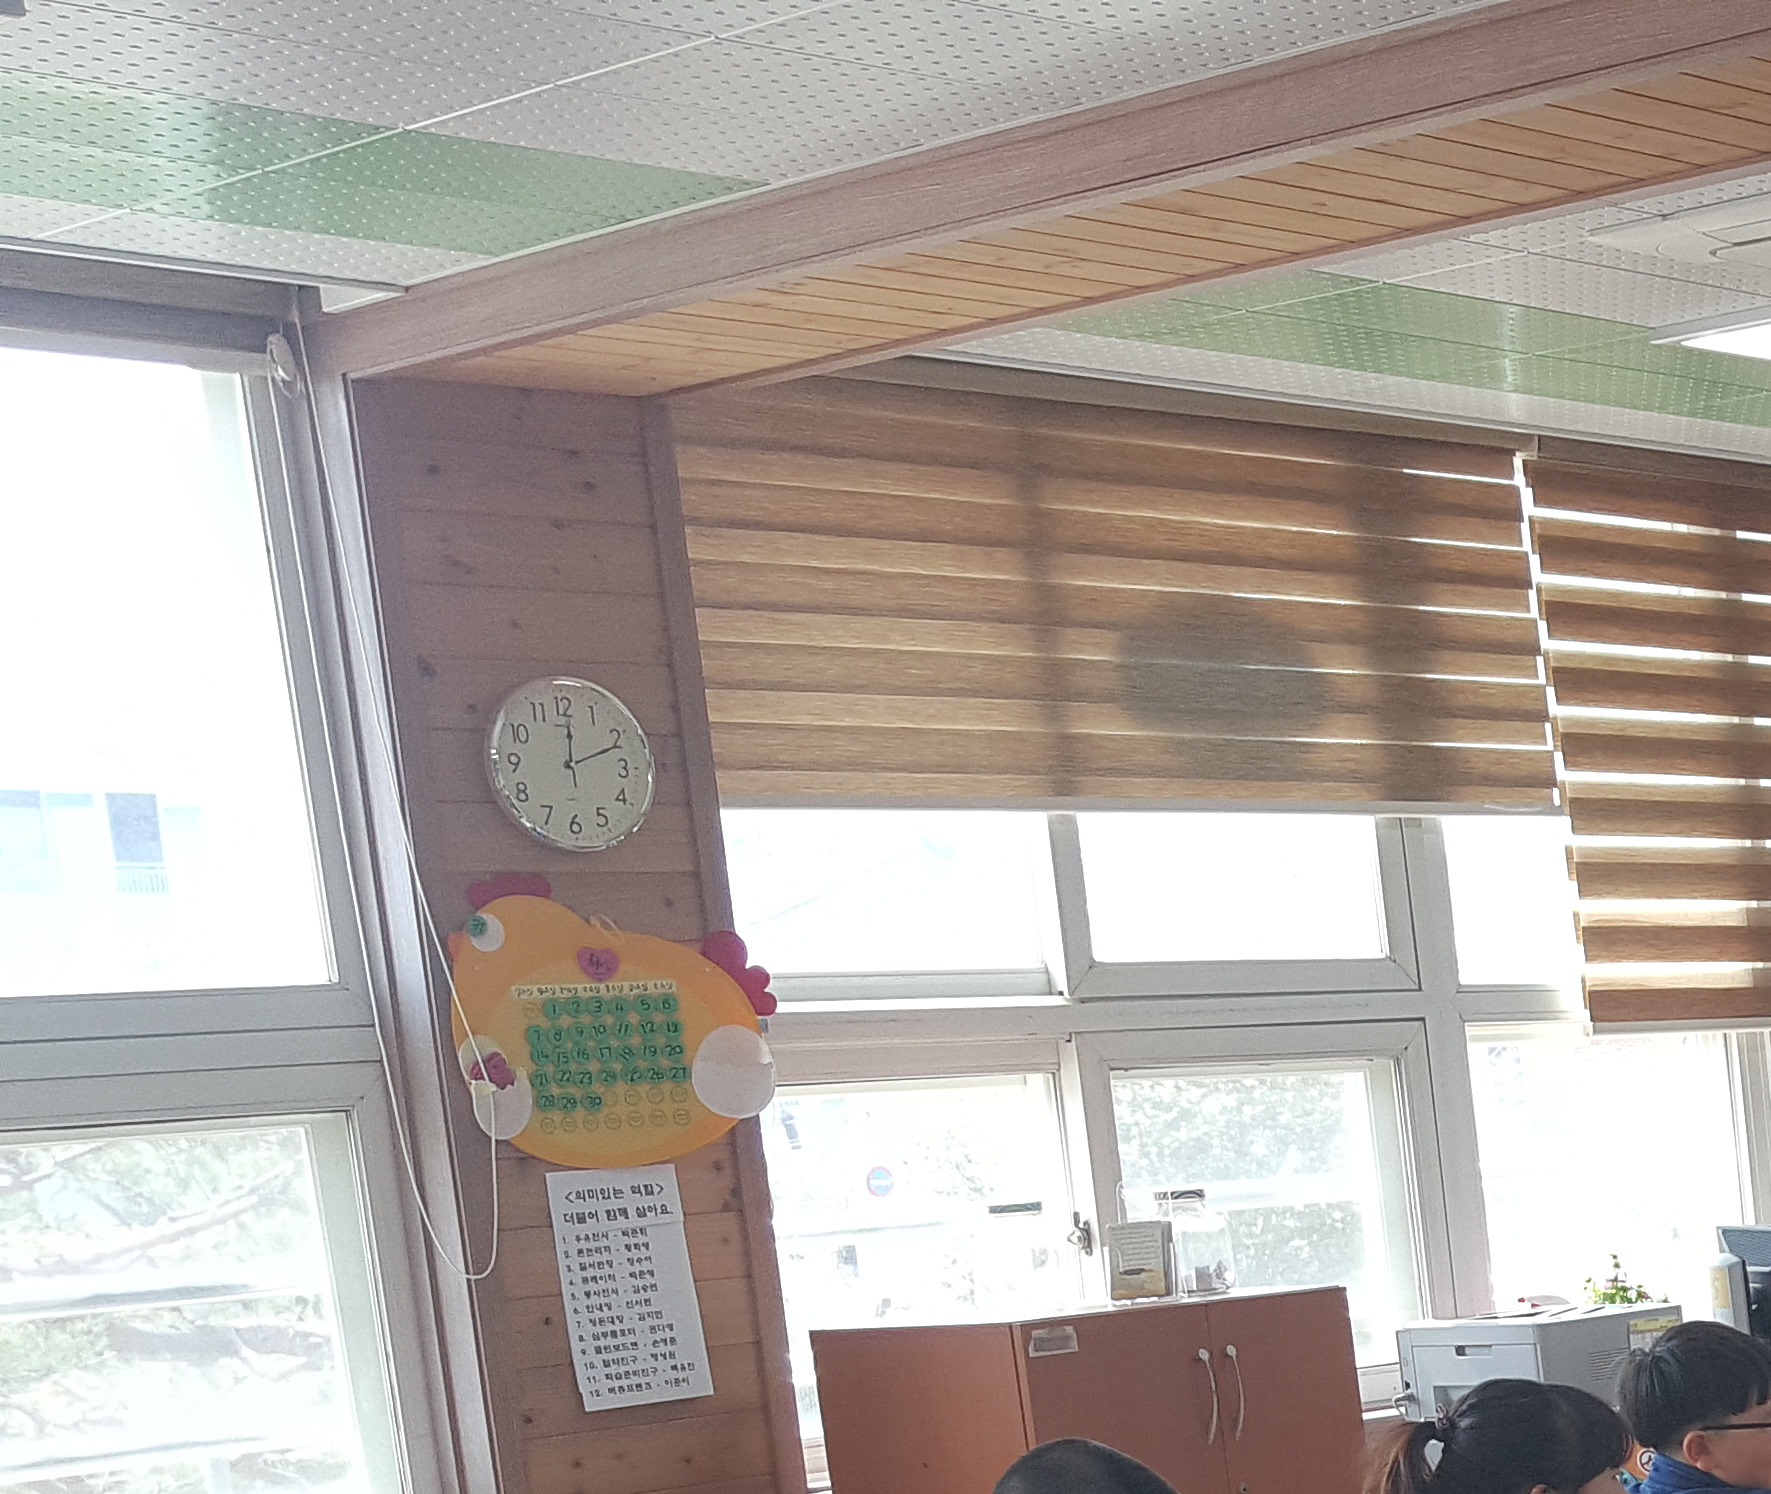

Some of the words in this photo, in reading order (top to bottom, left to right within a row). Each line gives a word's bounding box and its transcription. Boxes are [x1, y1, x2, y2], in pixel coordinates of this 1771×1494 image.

[530, 701, 546, 723] 11
[554, 697, 573, 717] 12
[587, 705, 596, 726] 1
[509, 723, 529, 744] 10
[609, 728, 623, 749] 2
[507, 752, 521, 773] 9
[617, 757, 629, 779] 3
[515, 782, 529, 802] 8
[615, 787, 627, 806] 4
[540, 805, 553, 825] 7
[569, 814, 582, 834] 6
[596, 807, 608, 827] 5
[564, 1186, 625, 1203] <의미있는
[563, 1211, 599, 1226] 더불어
